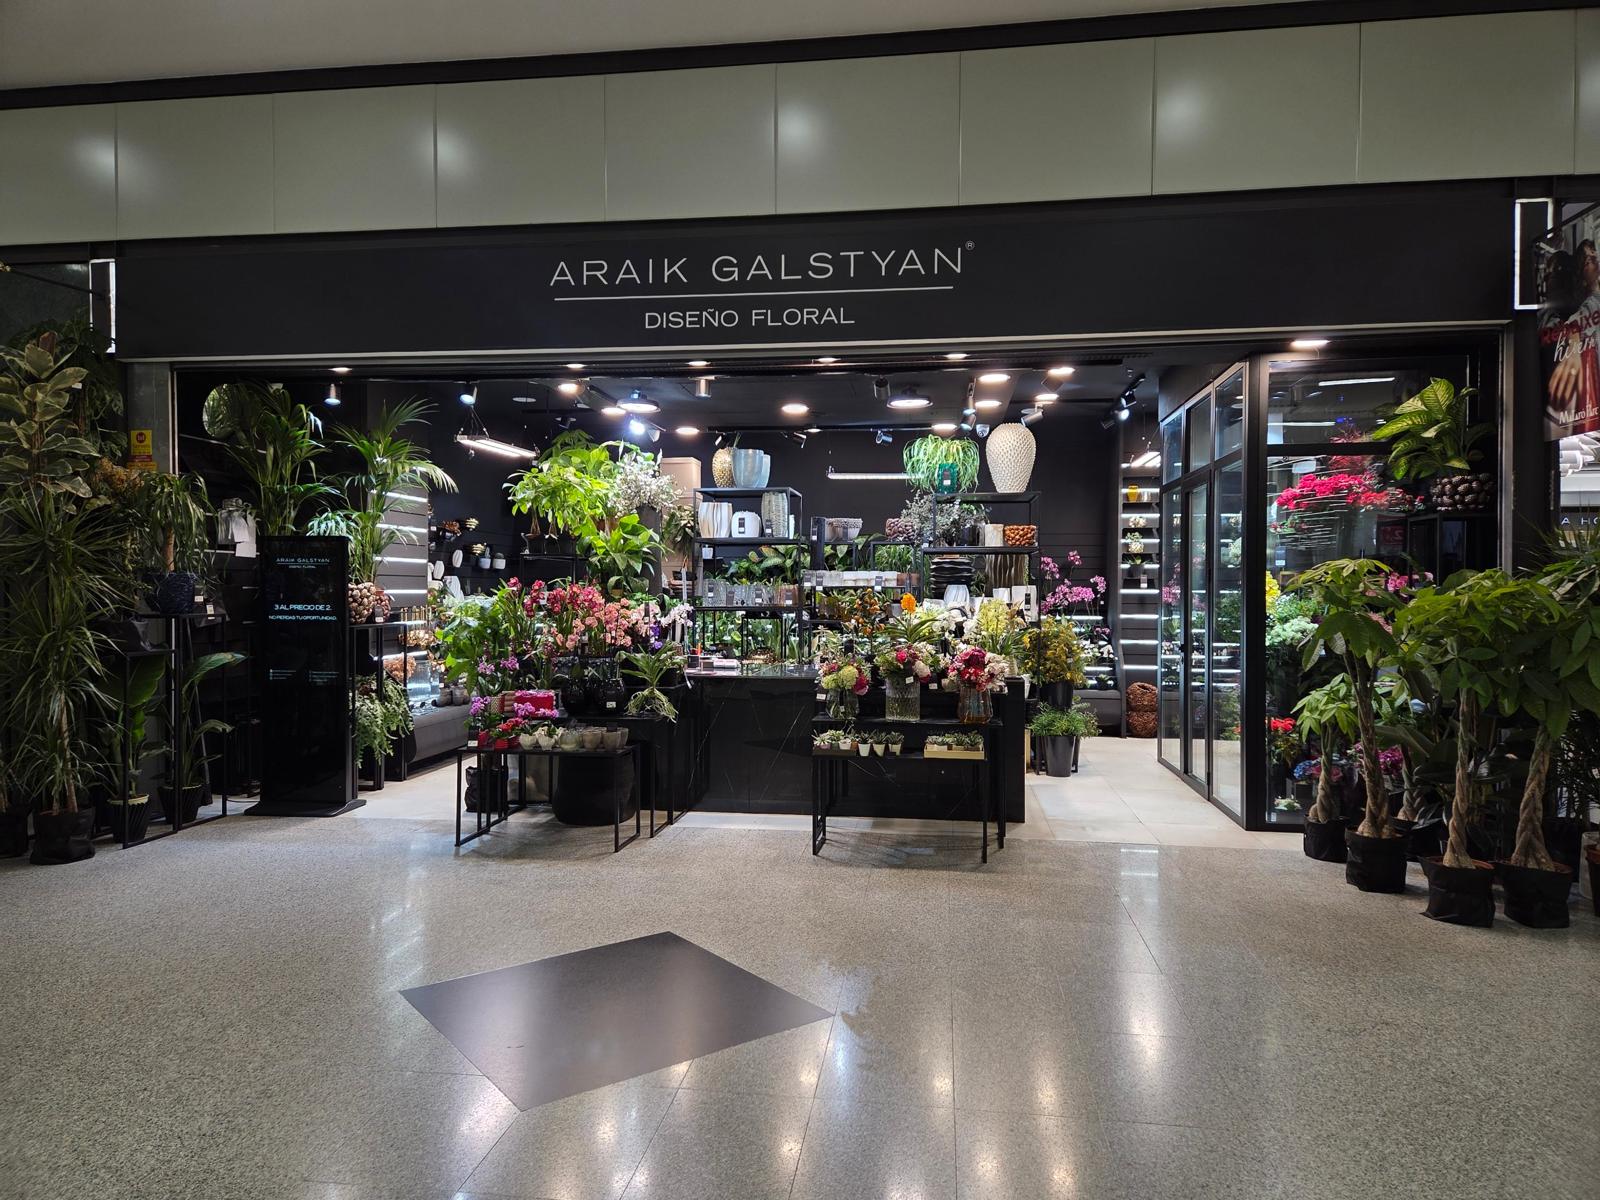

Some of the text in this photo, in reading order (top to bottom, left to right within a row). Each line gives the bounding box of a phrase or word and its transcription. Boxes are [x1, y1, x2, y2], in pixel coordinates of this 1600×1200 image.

[550, 247, 962, 287] ARAIK GALSTYAN
[644, 307, 856, 329] DISEÑO FLORAL
